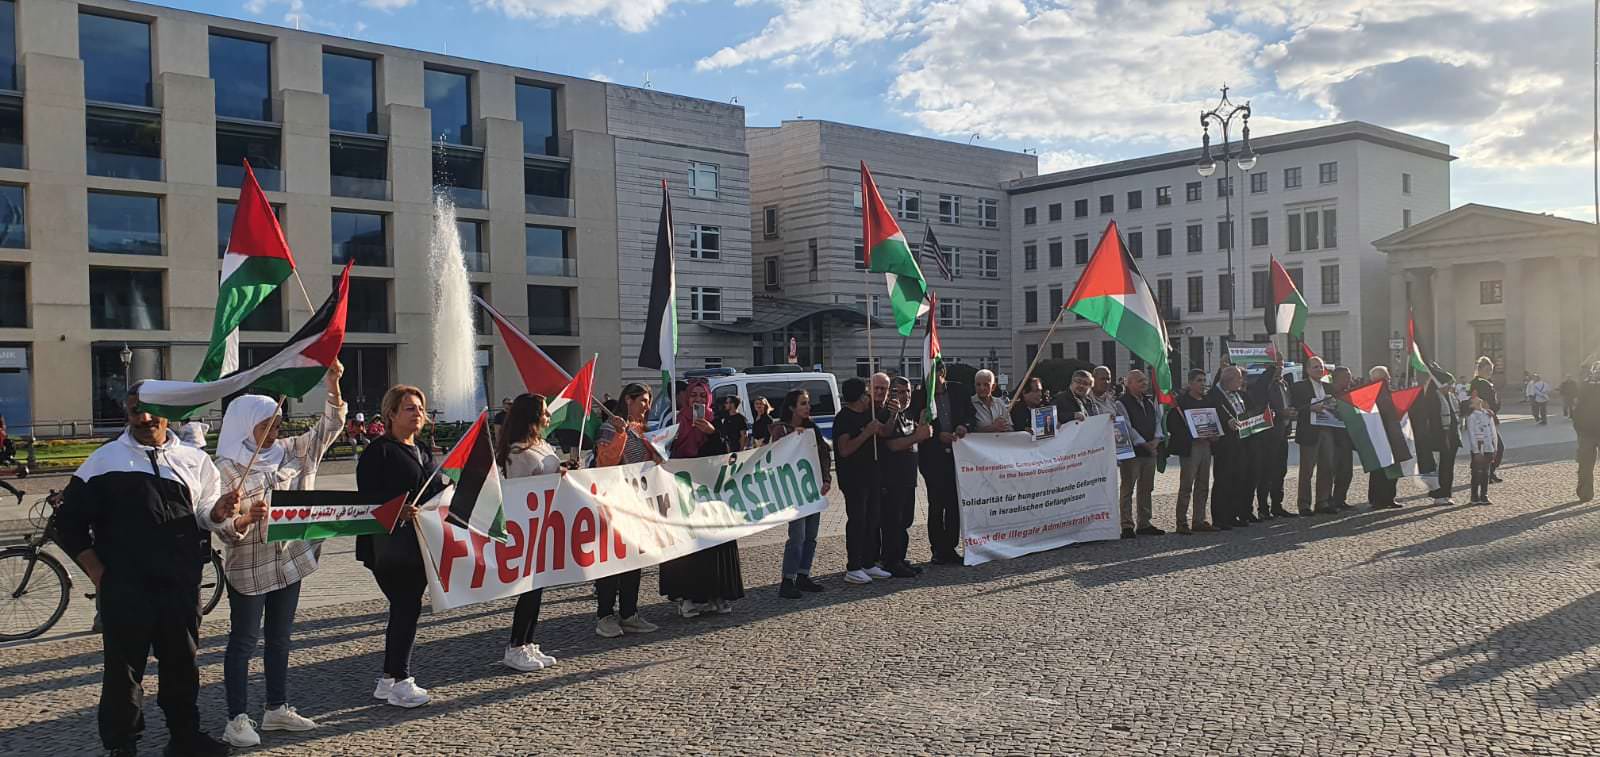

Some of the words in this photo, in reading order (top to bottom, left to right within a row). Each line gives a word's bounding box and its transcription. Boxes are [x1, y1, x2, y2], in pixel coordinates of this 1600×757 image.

[961, 465, 974, 473] The
[961, 495, 1003, 507] Solidarität
[1005, 493, 1017, 503] für
[1017, 484, 1076, 501] hungerstreikende
[336, 506, 346, 520] في
[989, 508, 997, 517] in
[1044, 493, 1086, 508] Gefängnissen
[437, 482, 627, 593] Freiheit
[673, 449, 822, 540] Palästina
[992, 532, 1007, 542] die
